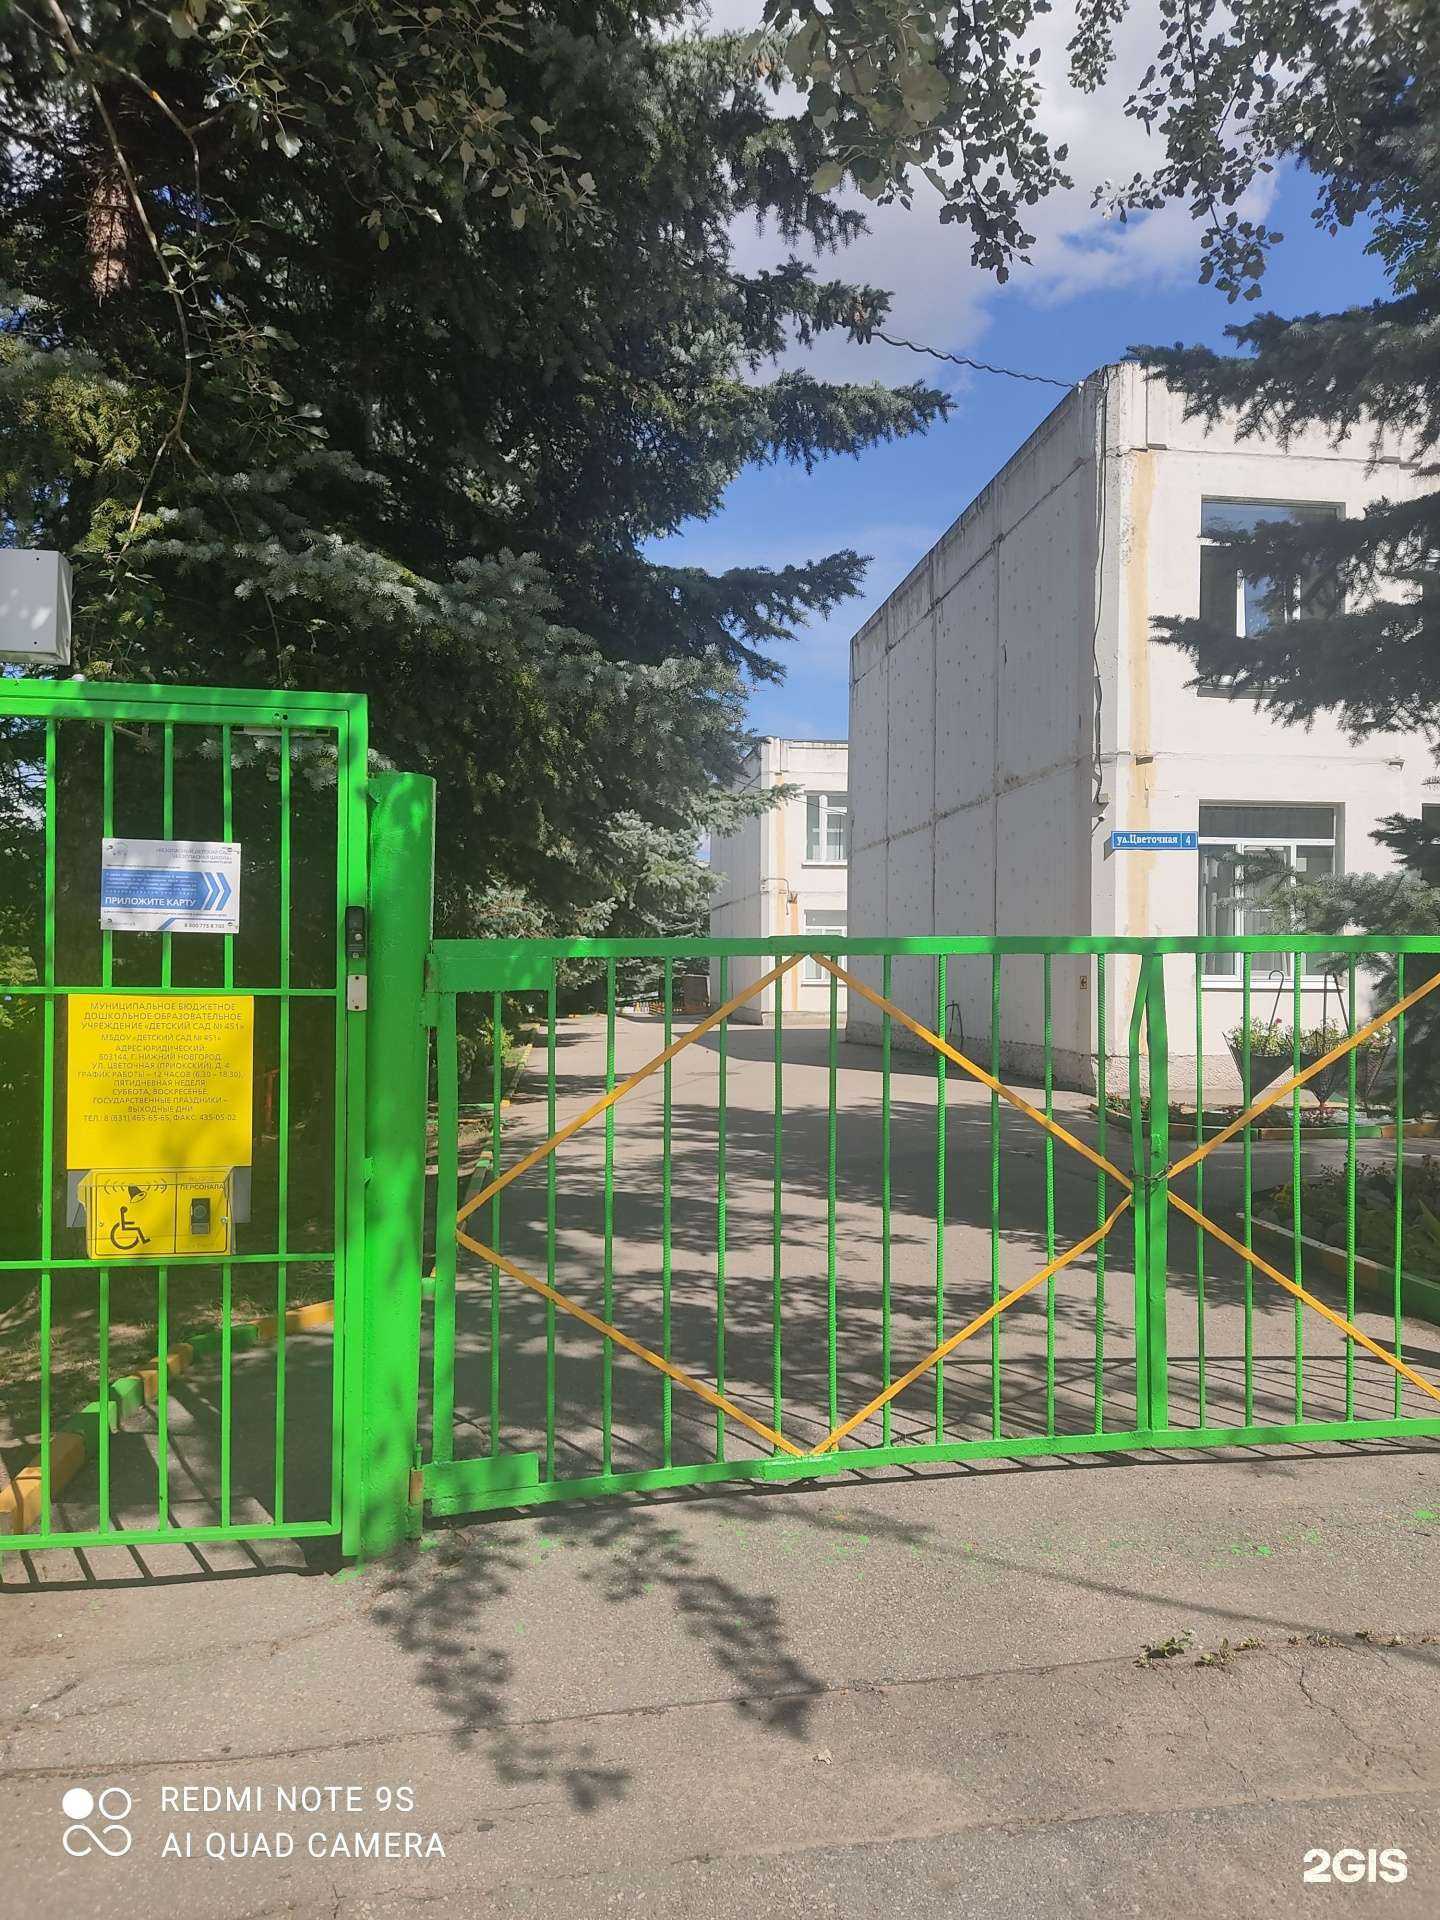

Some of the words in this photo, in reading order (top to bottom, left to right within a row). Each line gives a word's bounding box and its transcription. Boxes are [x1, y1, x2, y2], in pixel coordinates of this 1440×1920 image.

[1117, 834, 1178, 846] ул.Цветочная
[1185, 835, 1192, 846] 4
[105, 896, 165, 906] ПРИЛОЖИТЕ
[166, 898, 196, 907] КАРТУ
[90, 1002, 176, 1010] МУНИЦИПАЛЬНОЕ
[178, 1002, 236, 1010] БЮДЖЕТНОЕ
[84, 1012, 152, 1020] ДОШКОЛЬНОЕ
[154, 1012, 242, 1020] ОБРАЗОВАТЕЛЬНОЕ
[81, 1022, 143, 1030] УЧРЕЖДЕНИЕ
[144, 1022, 191, 1030] «ДЕТСКИЙ
[192, 1022, 211, 1030] САД
